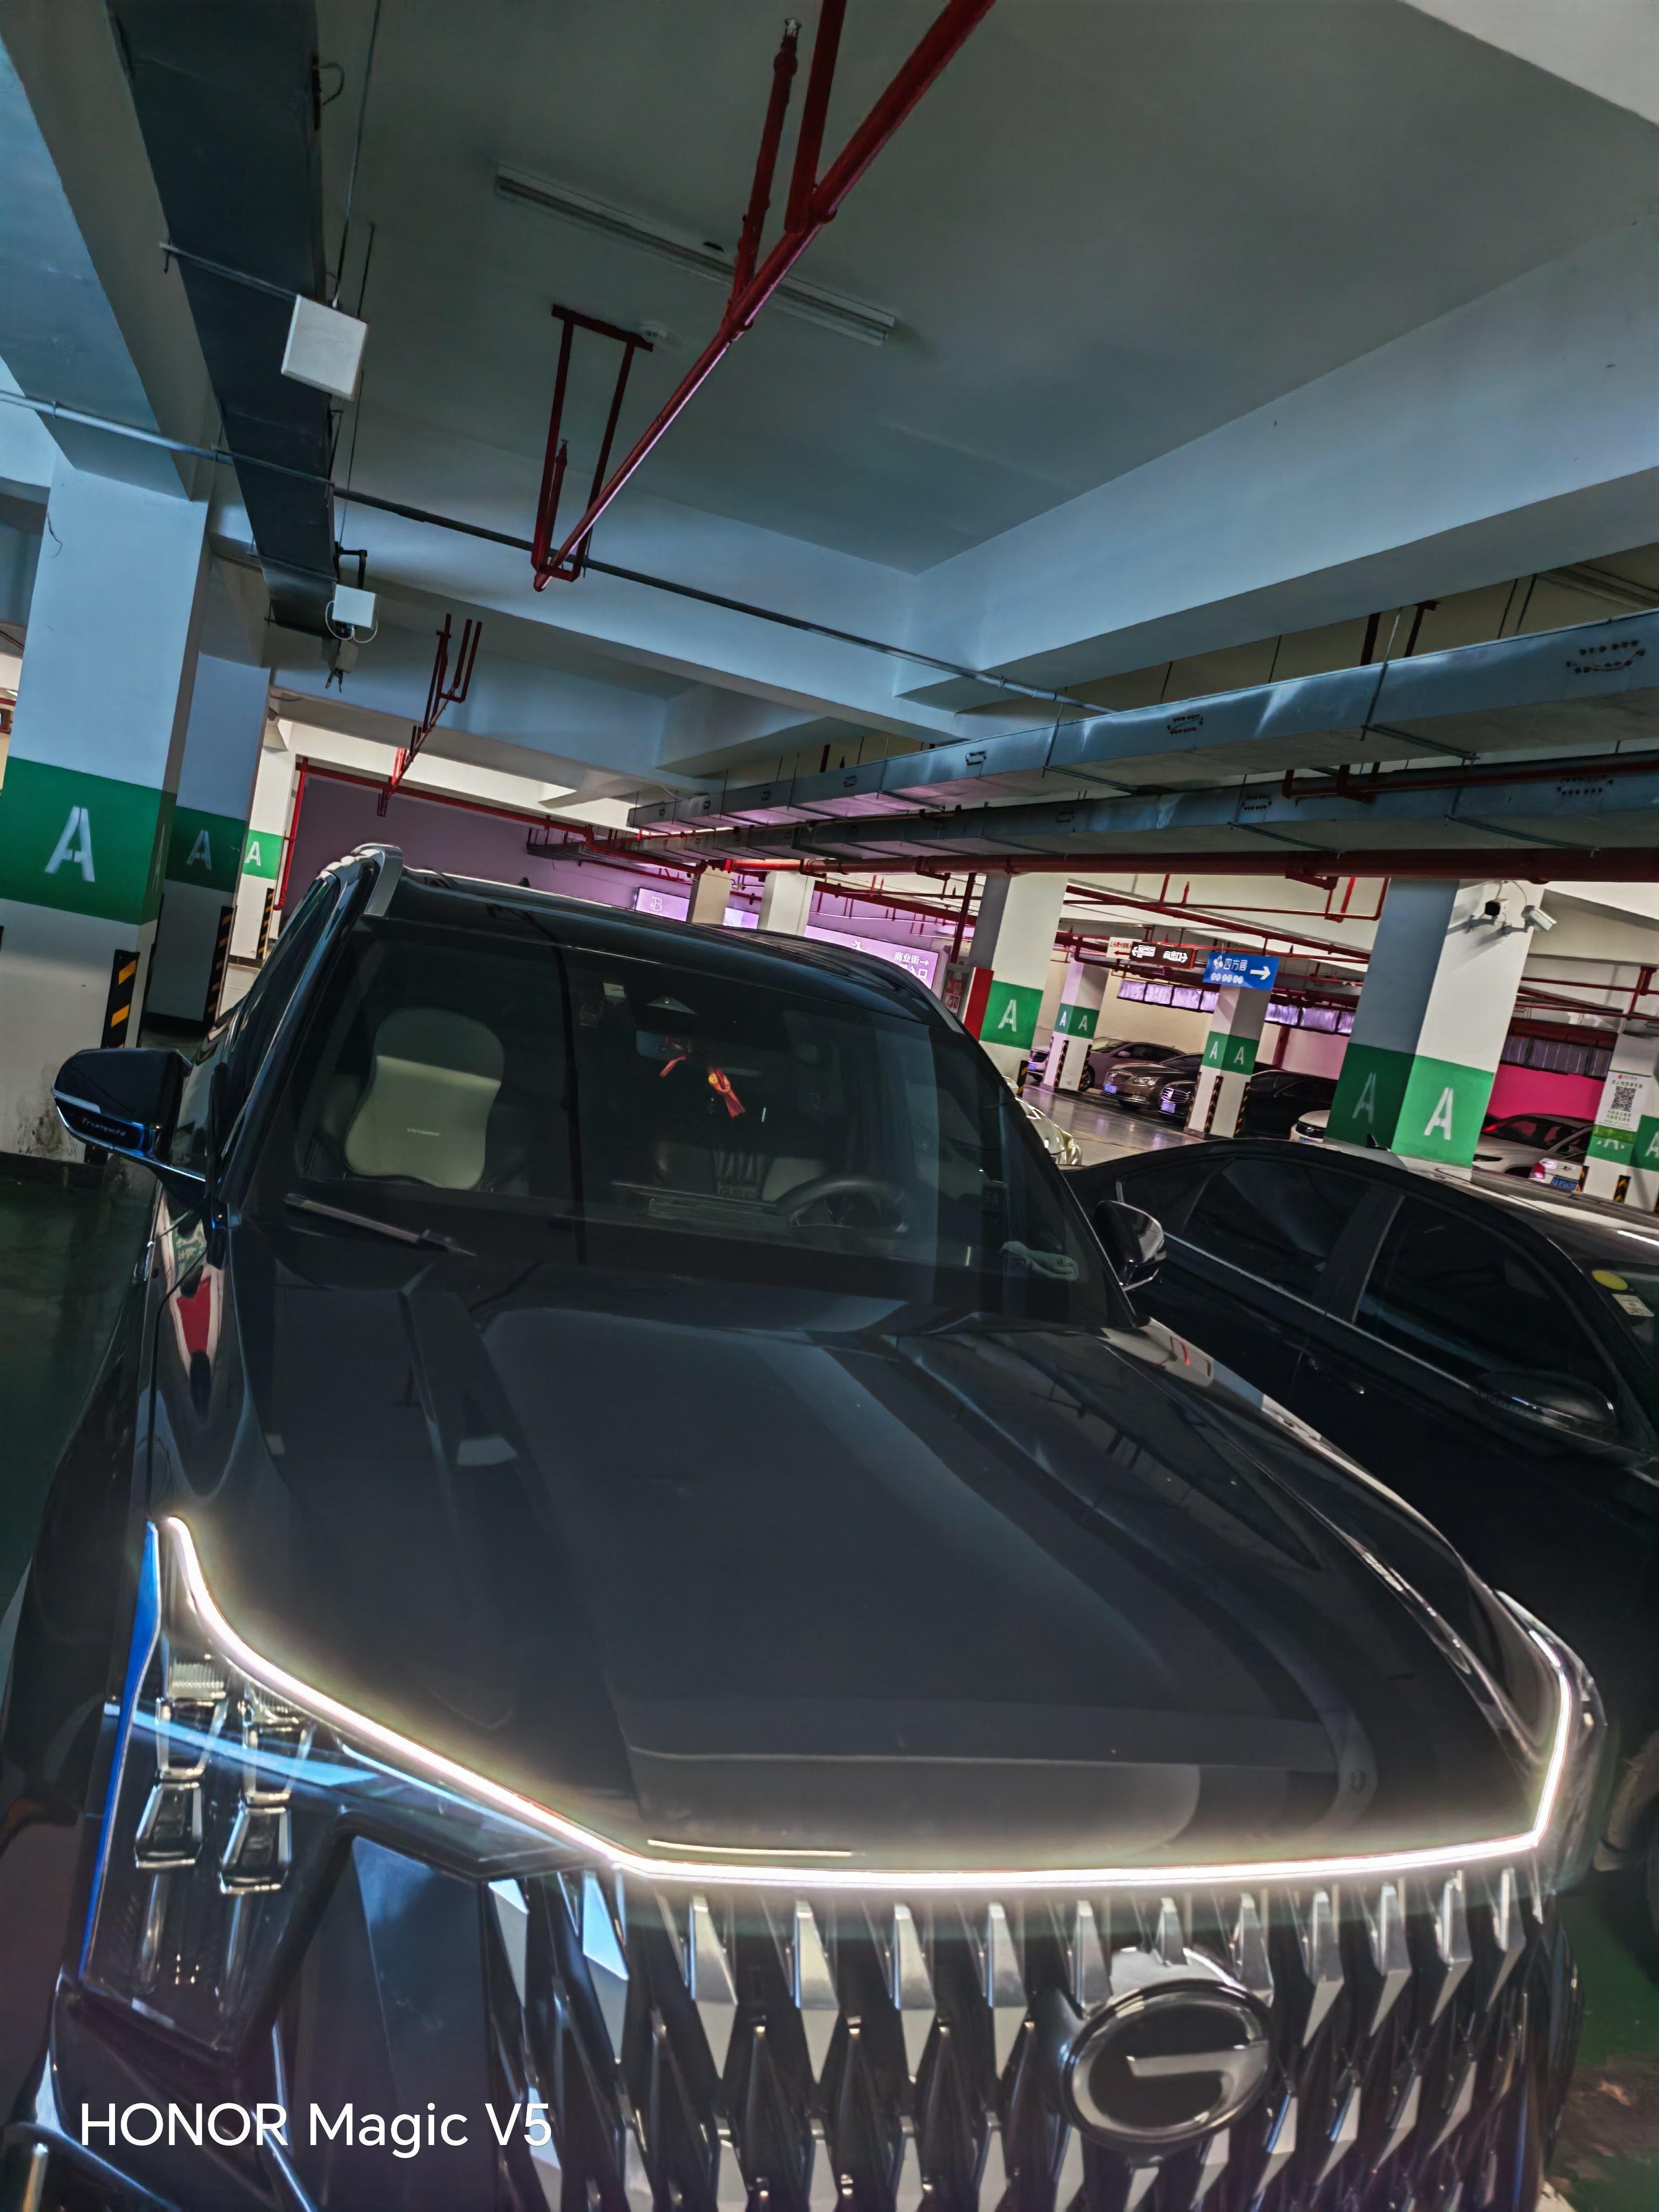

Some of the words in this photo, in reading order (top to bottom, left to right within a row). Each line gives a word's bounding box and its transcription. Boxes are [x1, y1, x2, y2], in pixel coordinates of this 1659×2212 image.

[44, 806, 95, 882] A
[186, 830, 212, 871] A
[244, 841, 261, 866] A
[894, 952, 920, 965] 商业街
[997, 999, 1017, 1032] A
[1060, 1011, 1067, 1027] A
[1078, 1015, 1087, 1031] A
[1209, 1041, 1218, 1060] A
[1233, 1046, 1244, 1065] A
[1352, 1073, 1376, 1123] A
[1424, 1087, 1453, 1141] A
